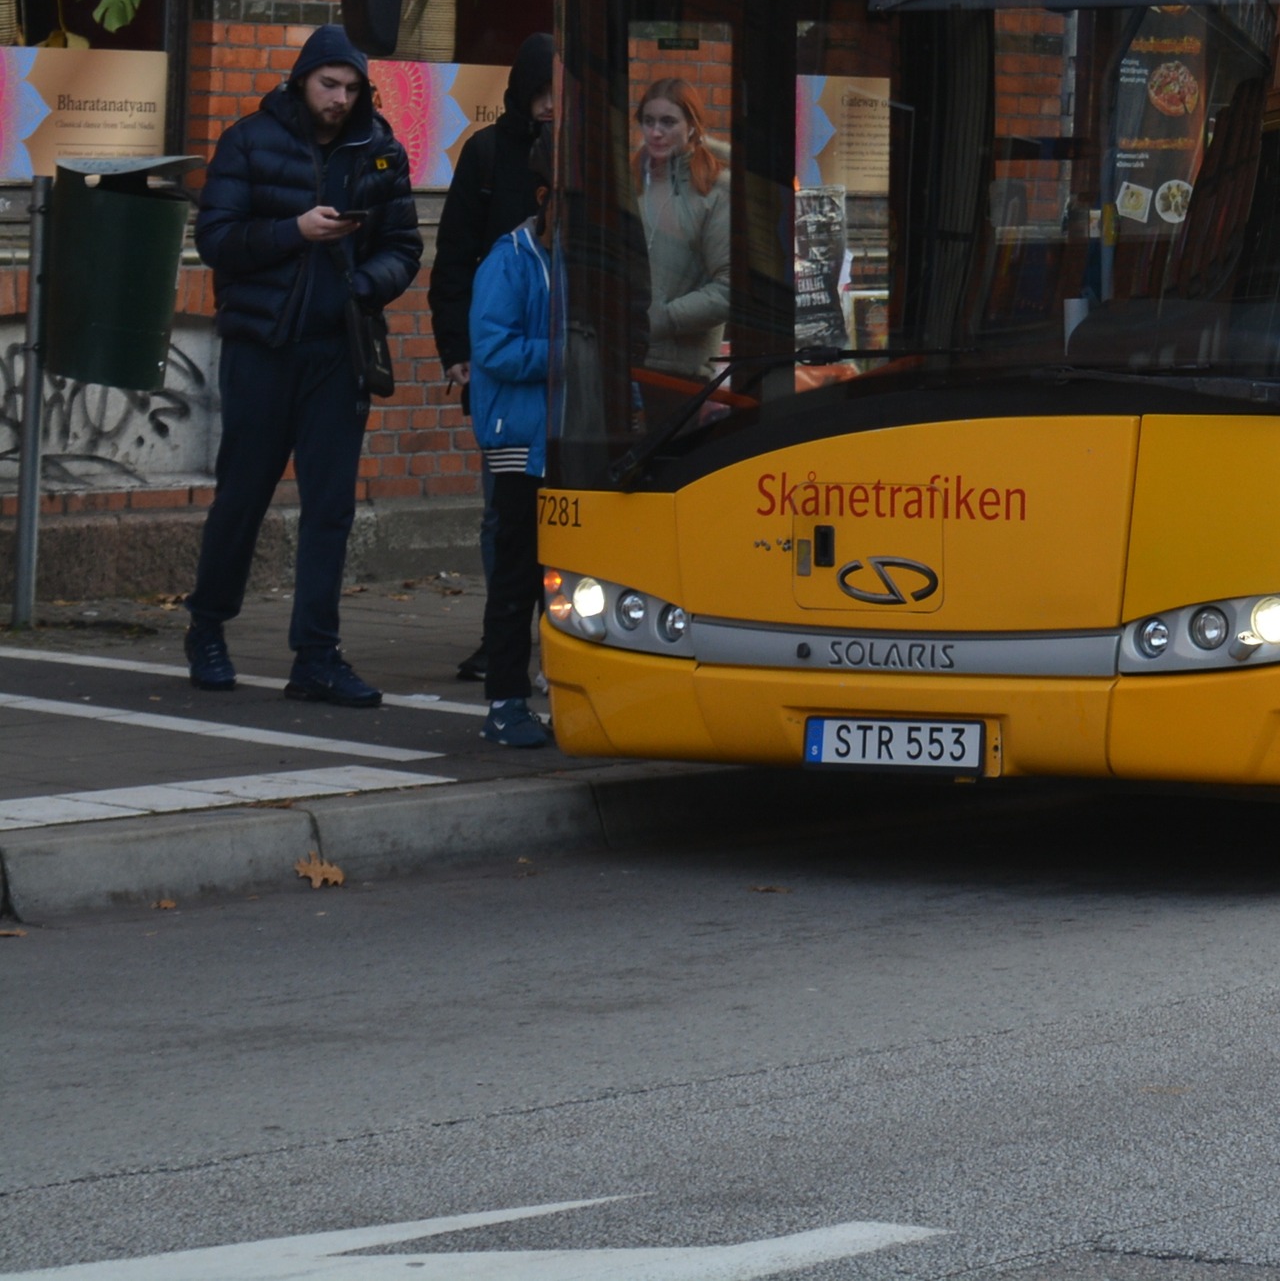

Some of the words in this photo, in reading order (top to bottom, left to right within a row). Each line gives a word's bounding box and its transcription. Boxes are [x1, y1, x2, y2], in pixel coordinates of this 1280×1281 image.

[57, 94, 157, 117] Bharatanatyam
[539, 495, 582, 528] 7281
[756, 471, 1026, 521] Skånetrafiken
[829, 640, 955, 669] SOLARIS
[834, 724, 895, 760] STR
[906, 726, 967, 761] 553
